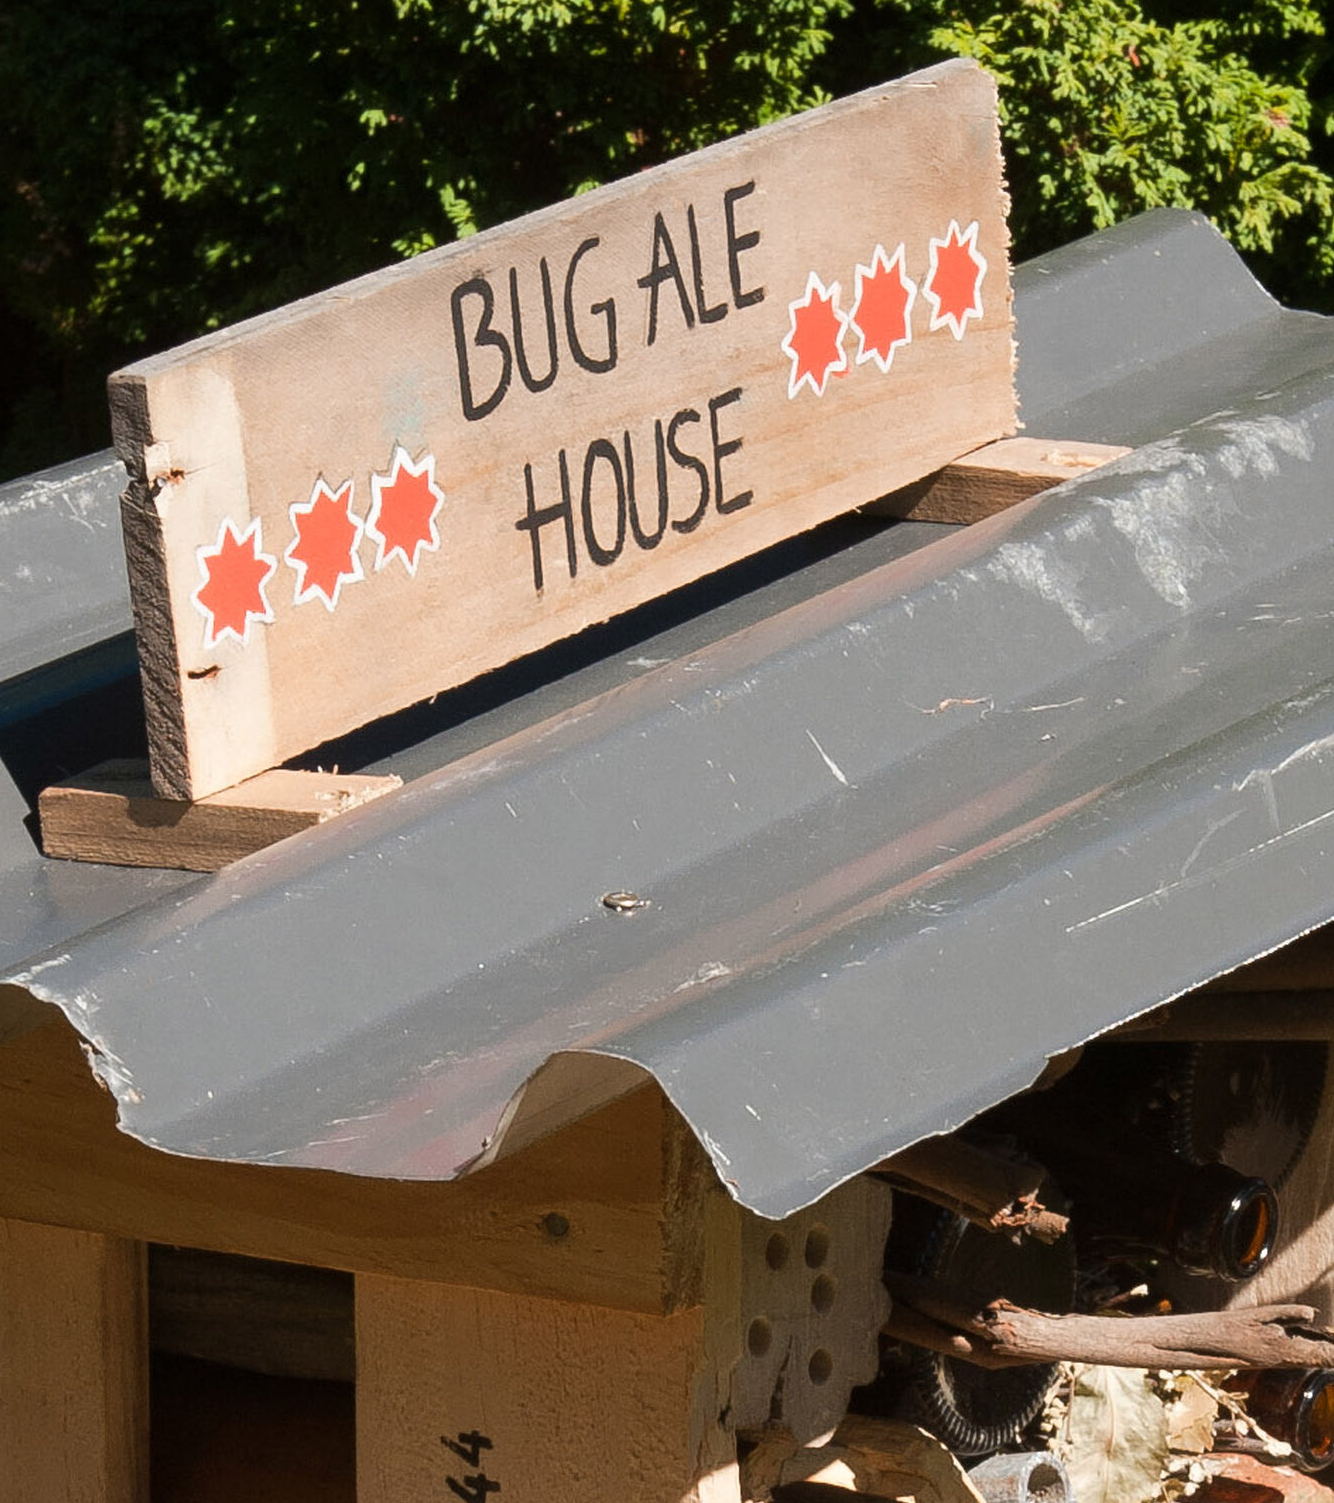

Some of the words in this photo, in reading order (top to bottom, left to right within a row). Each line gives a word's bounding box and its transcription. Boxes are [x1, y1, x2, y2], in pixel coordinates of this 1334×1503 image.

[449, 236, 618, 422] BUG
[638, 180, 765, 346] ALE
[516, 386, 755, 597] HOUSE
